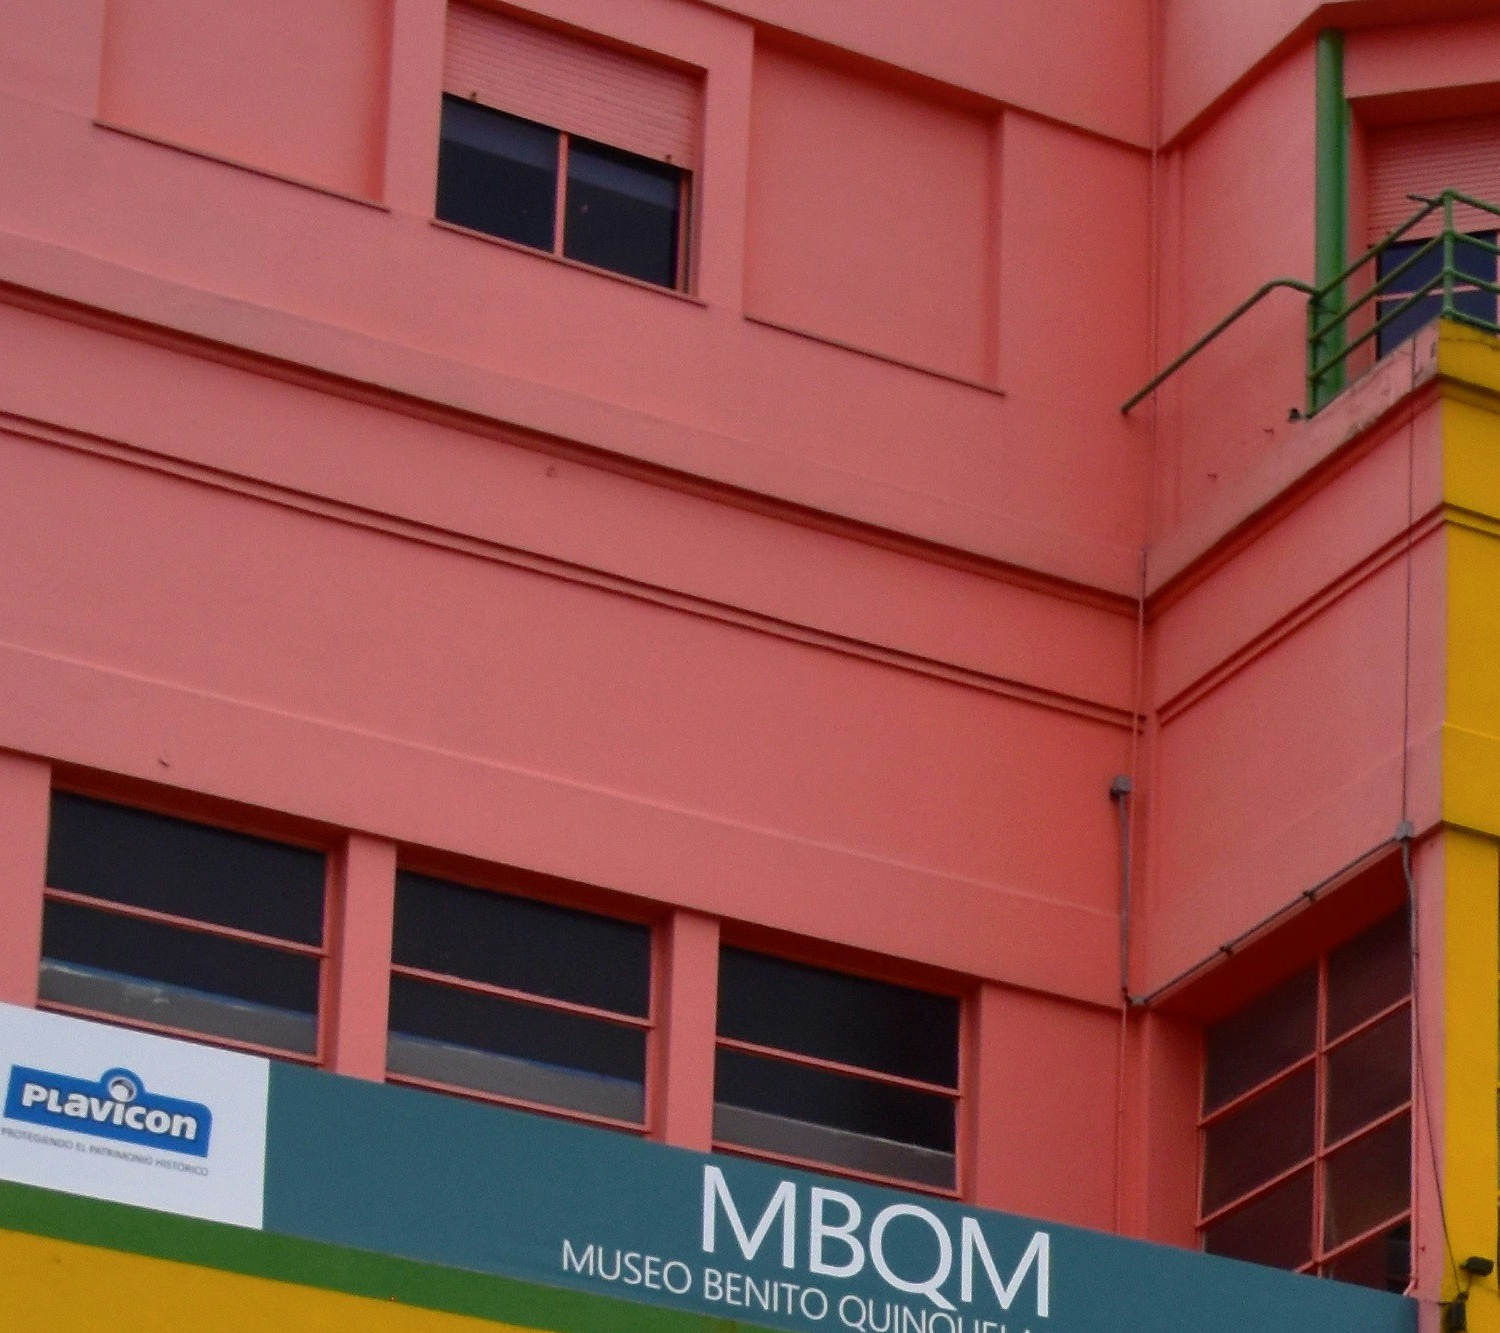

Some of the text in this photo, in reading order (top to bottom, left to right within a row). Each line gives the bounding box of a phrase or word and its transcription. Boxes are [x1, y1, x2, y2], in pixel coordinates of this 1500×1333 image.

[562, 1239, 693, 1296] MUSEO
[703, 1268, 829, 1324] BENITO
[702, 1165, 1052, 1318] MBQM
